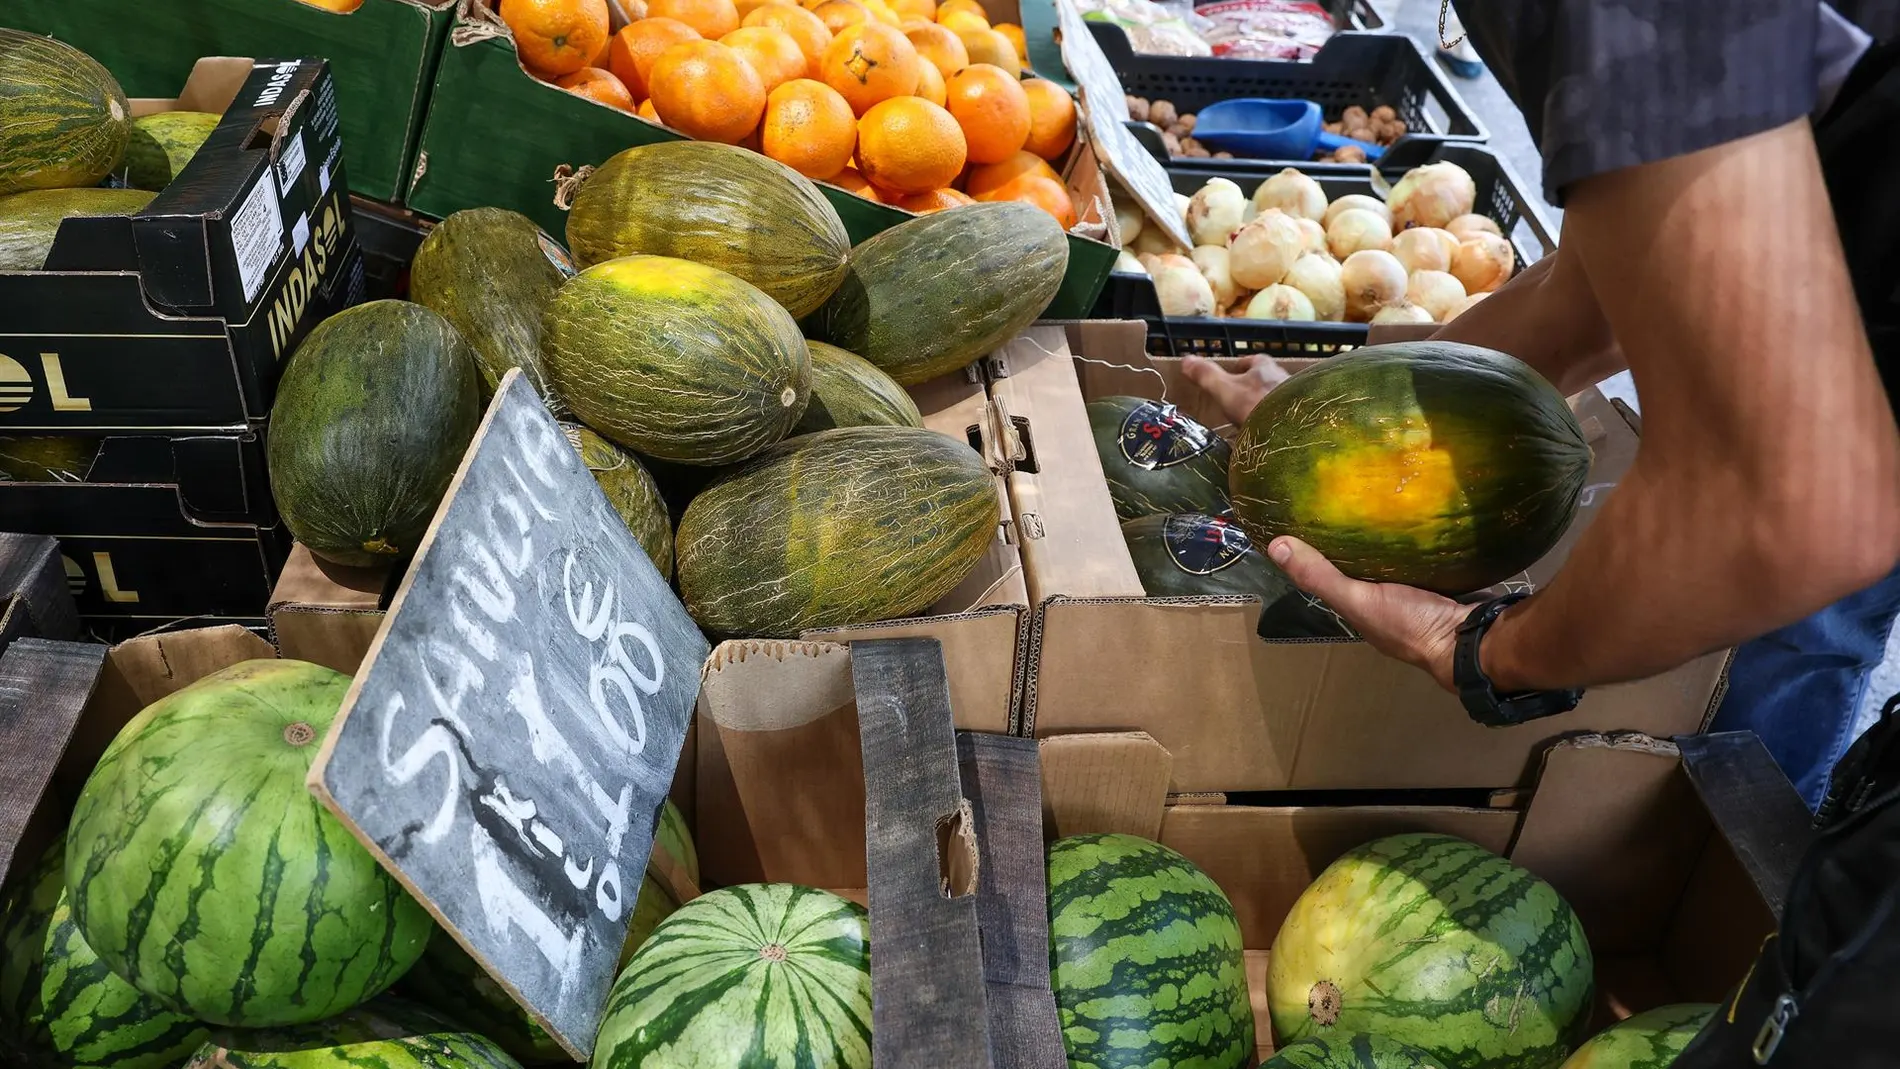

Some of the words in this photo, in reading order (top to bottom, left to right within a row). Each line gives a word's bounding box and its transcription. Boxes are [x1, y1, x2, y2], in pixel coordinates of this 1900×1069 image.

[253, 58, 302, 107] INDASOL
[268, 191, 346, 360] INDASOL
[480, 775, 622, 922] KILO
